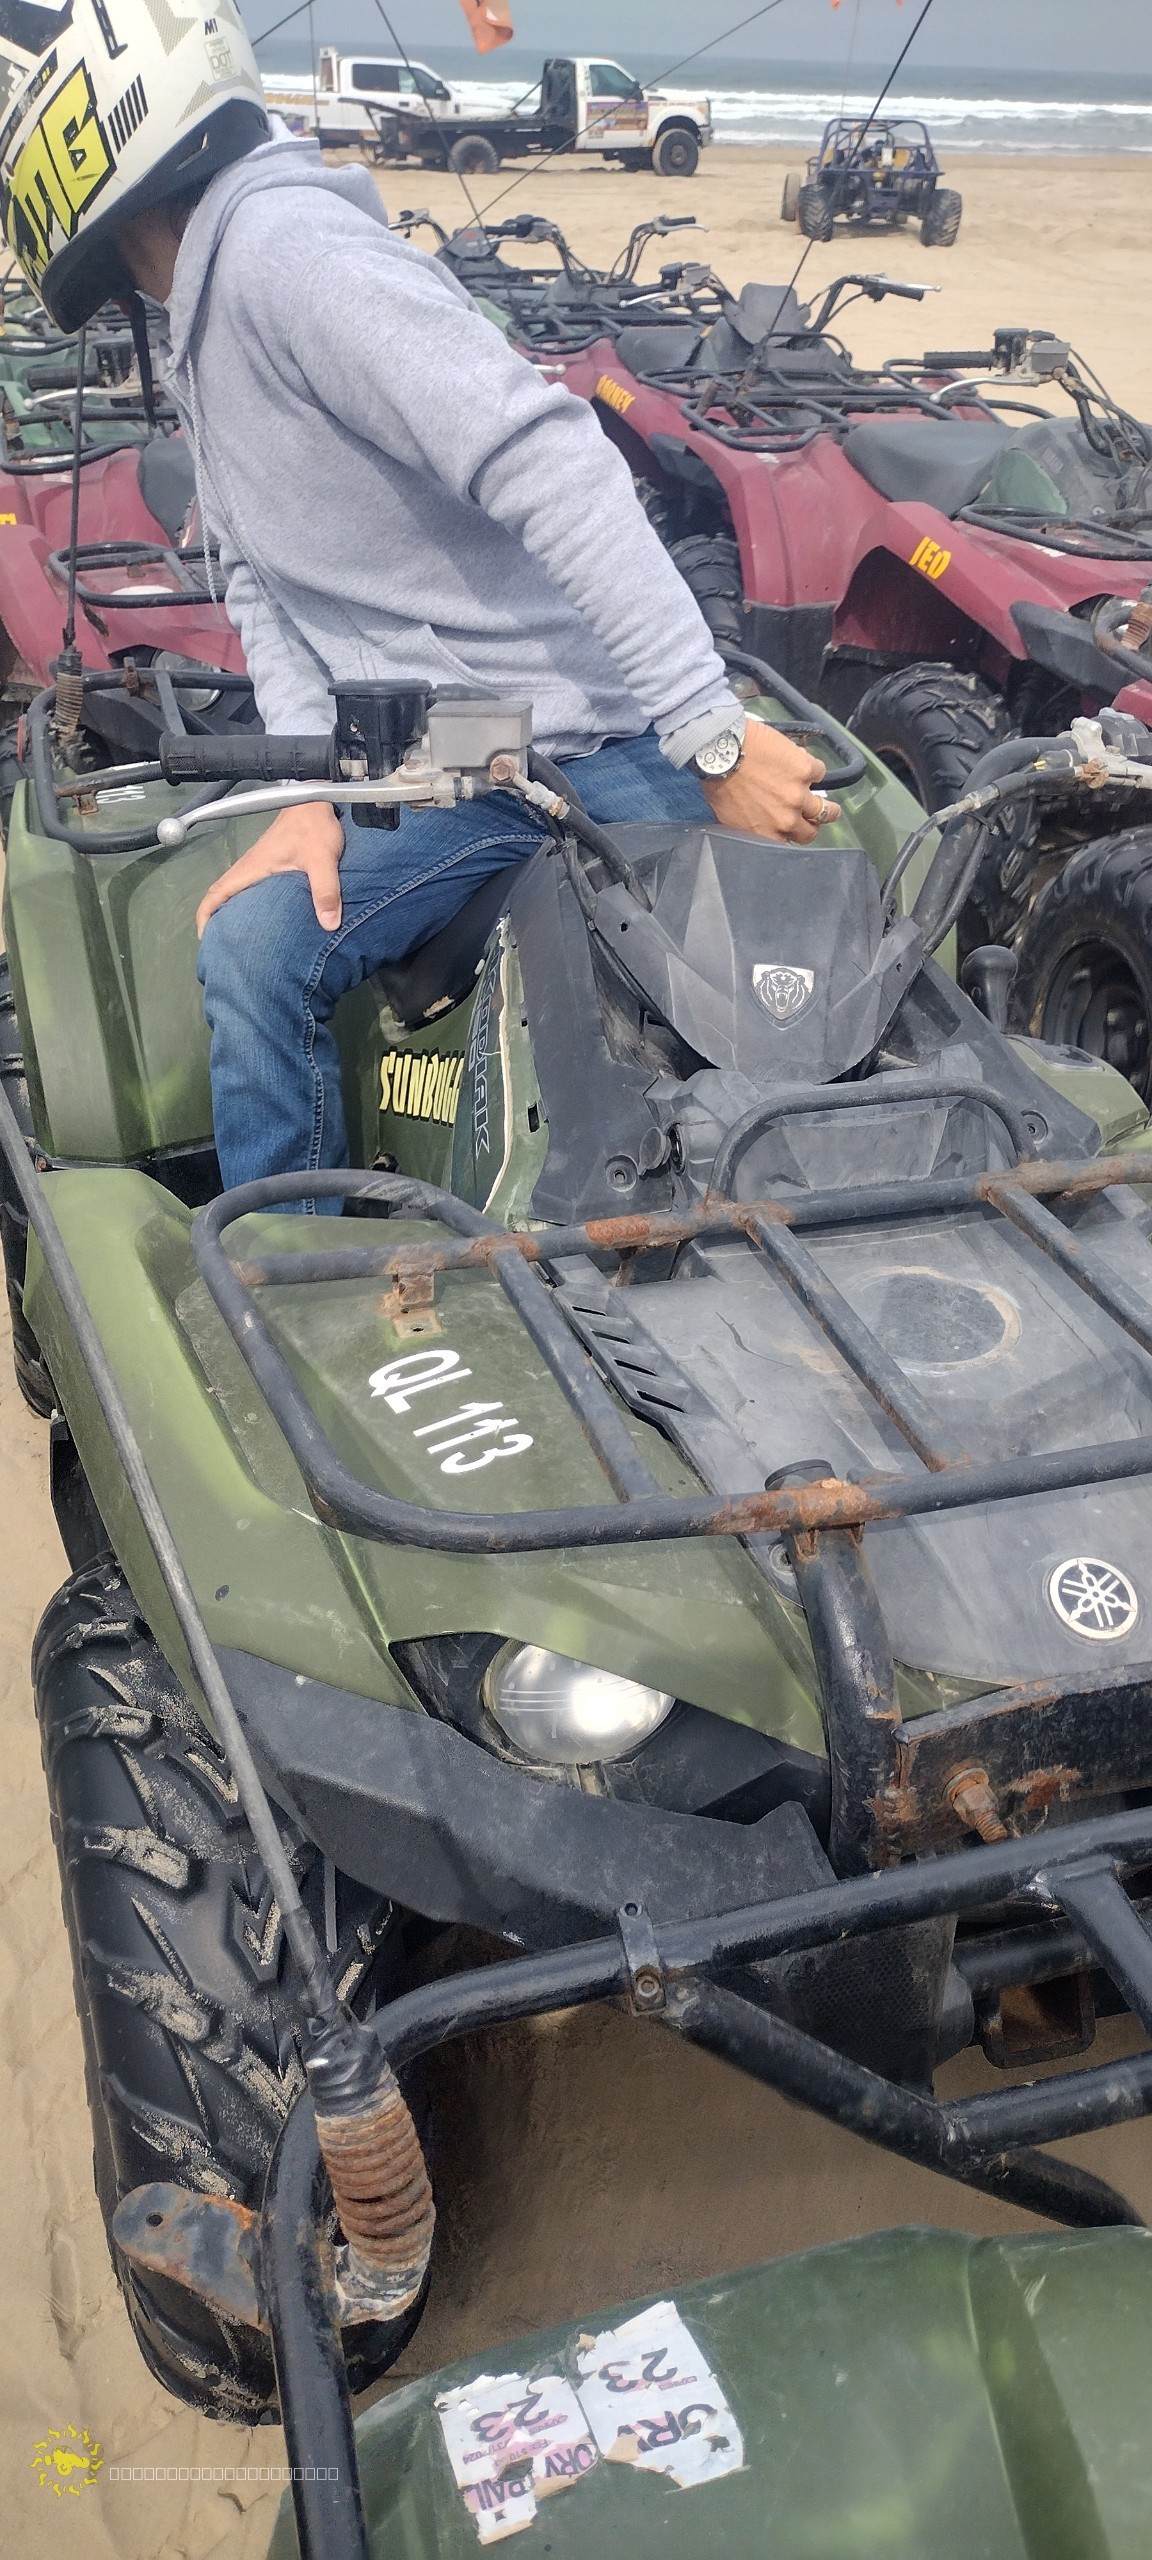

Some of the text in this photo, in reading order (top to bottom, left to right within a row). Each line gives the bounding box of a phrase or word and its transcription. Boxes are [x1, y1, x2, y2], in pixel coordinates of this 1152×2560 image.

[209, 49, 232, 70] DOT
[368, 1349, 535, 1474] QL 113
[598, 2347, 678, 2392] 23
[470, 2393, 549, 2442] 23
[545, 2443, 594, 2478] ORV
